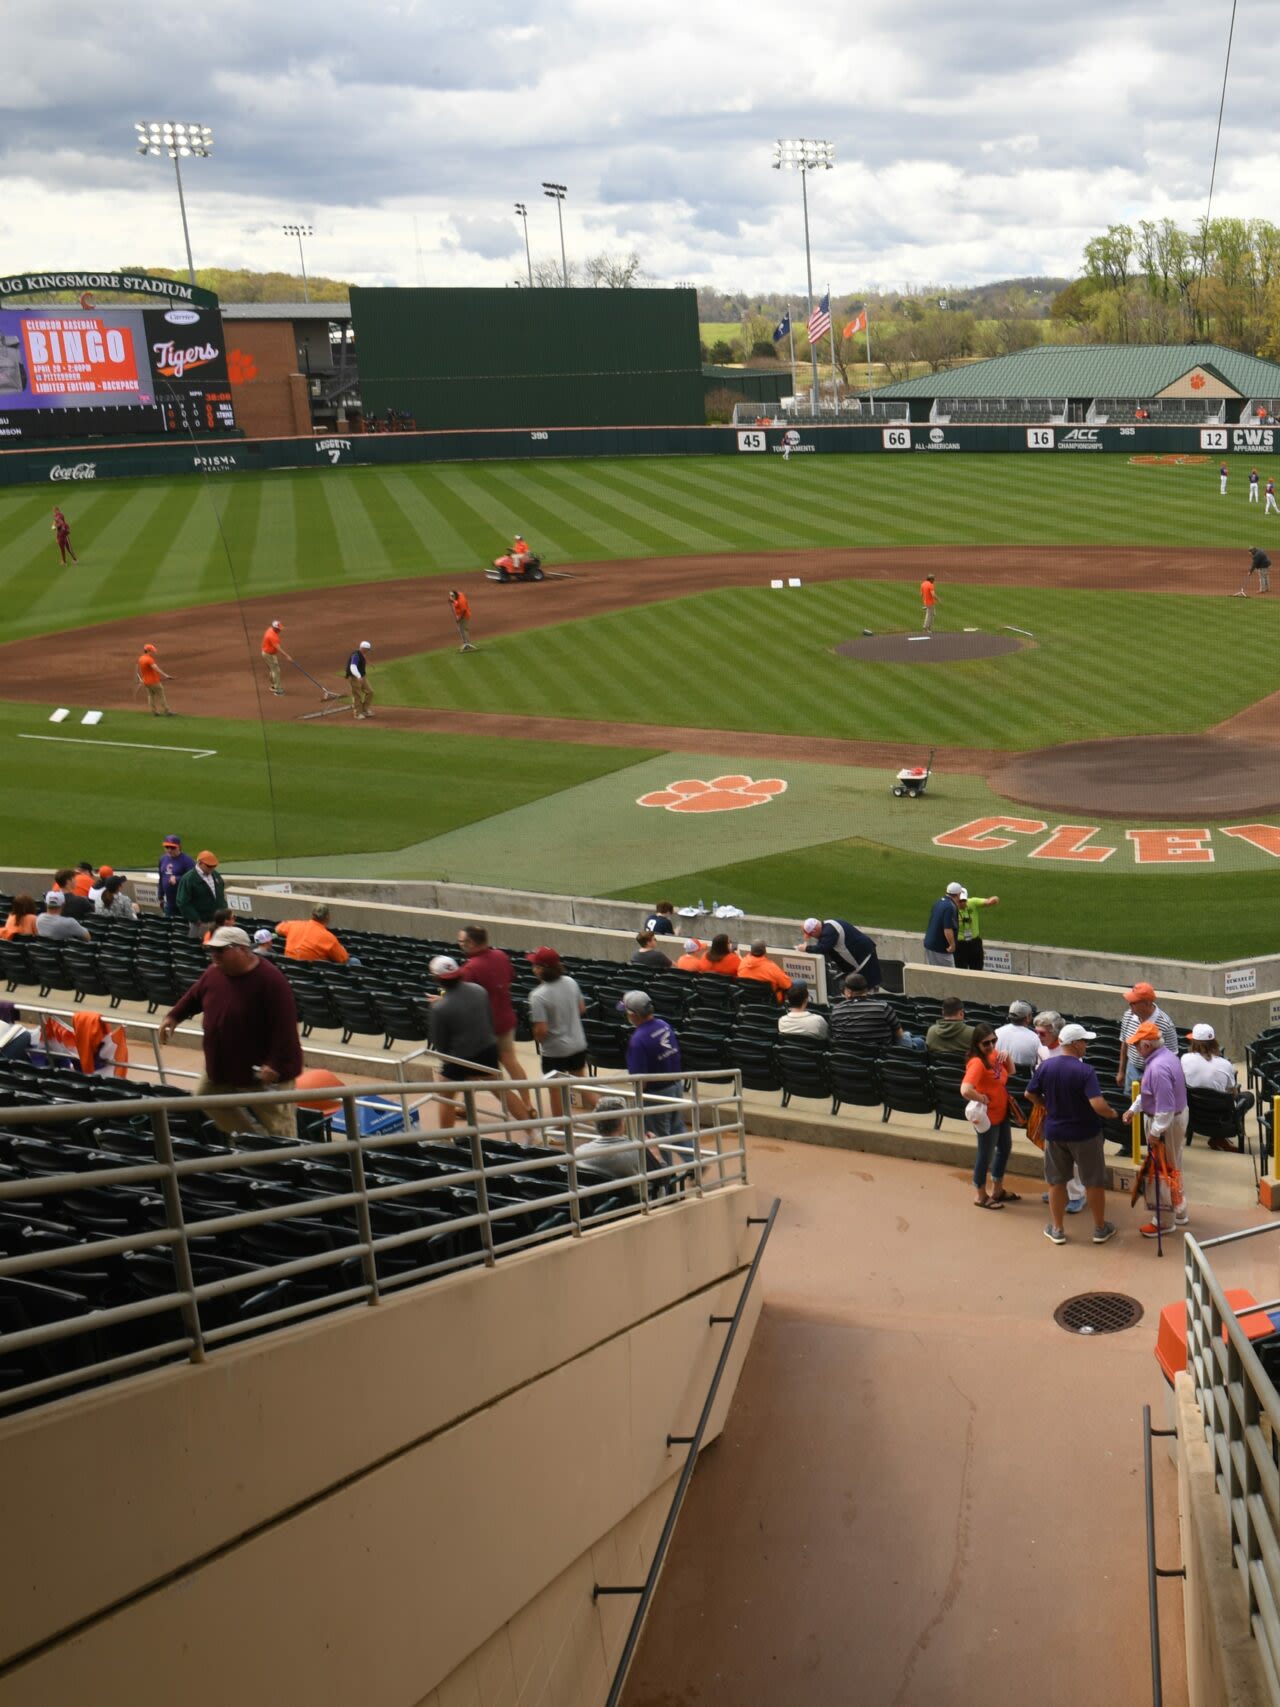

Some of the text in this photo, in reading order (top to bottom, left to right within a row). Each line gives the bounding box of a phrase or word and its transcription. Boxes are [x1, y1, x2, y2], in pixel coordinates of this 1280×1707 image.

[26, 275, 120, 290] KINGSMORE
[123, 277, 192, 300] STADIUM
[26, 319, 99, 331] CLEMSON BASEBALL
[28, 330, 125, 364] BINGO
[153, 341, 219, 378] Tigers
[36, 382, 65, 392] LIMITED
[66, 381, 96, 391] EDITION
[102, 381, 139, 391] BACKPACK
[219, 403, 232, 411] BALL
[216, 411, 234, 419] STRIKE
[224, 419, 235, 427] OUT
[531, 431, 549, 440] 390
[1063, 429, 1101, 440] ACC
[1120, 428, 1136, 436] 365
[1233, 430, 1274, 446] CWS
[744, 434, 761, 448] 45
[889, 432, 906, 446] 66
[1033, 432, 1049, 445] 16
[1207, 432, 1222, 446] 12
[315, 439, 351, 452] LEGGETT
[1057, 442, 1103, 450] CHAMPIONSHIPS
[193, 456, 237, 467] PRISMA
[328, 450, 340, 464] 7
[1226, 976, 1247, 985] BEWARE
